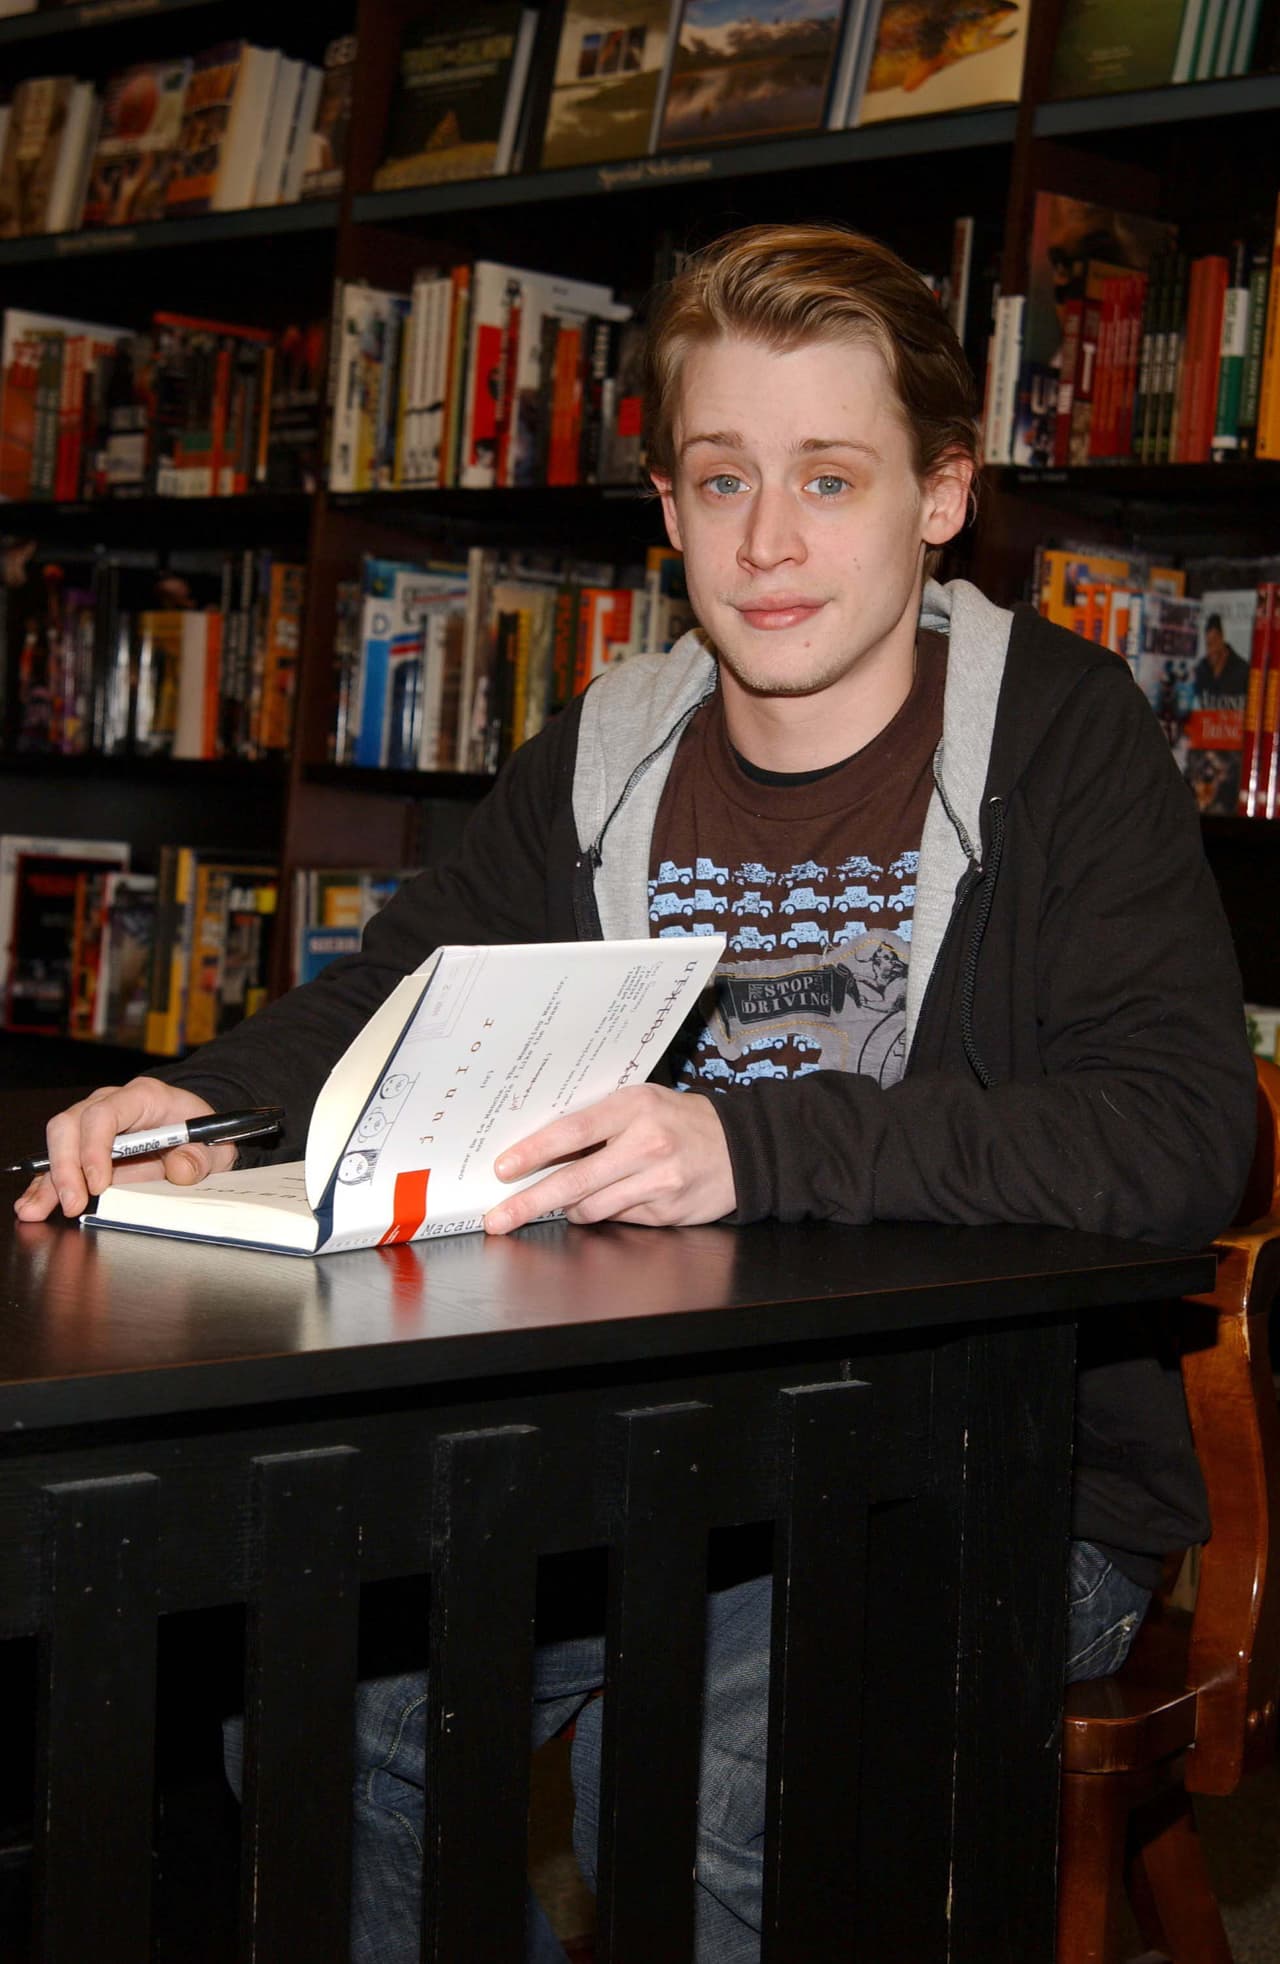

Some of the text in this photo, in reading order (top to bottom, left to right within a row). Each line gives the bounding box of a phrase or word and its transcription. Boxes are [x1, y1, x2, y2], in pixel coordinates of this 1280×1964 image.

[763, 976, 813, 998] STOP
[742, 992, 831, 1014] DRIVING
[112, 1138, 161, 1157] Sharpie
[419, 1213, 487, 1238] Macaul
